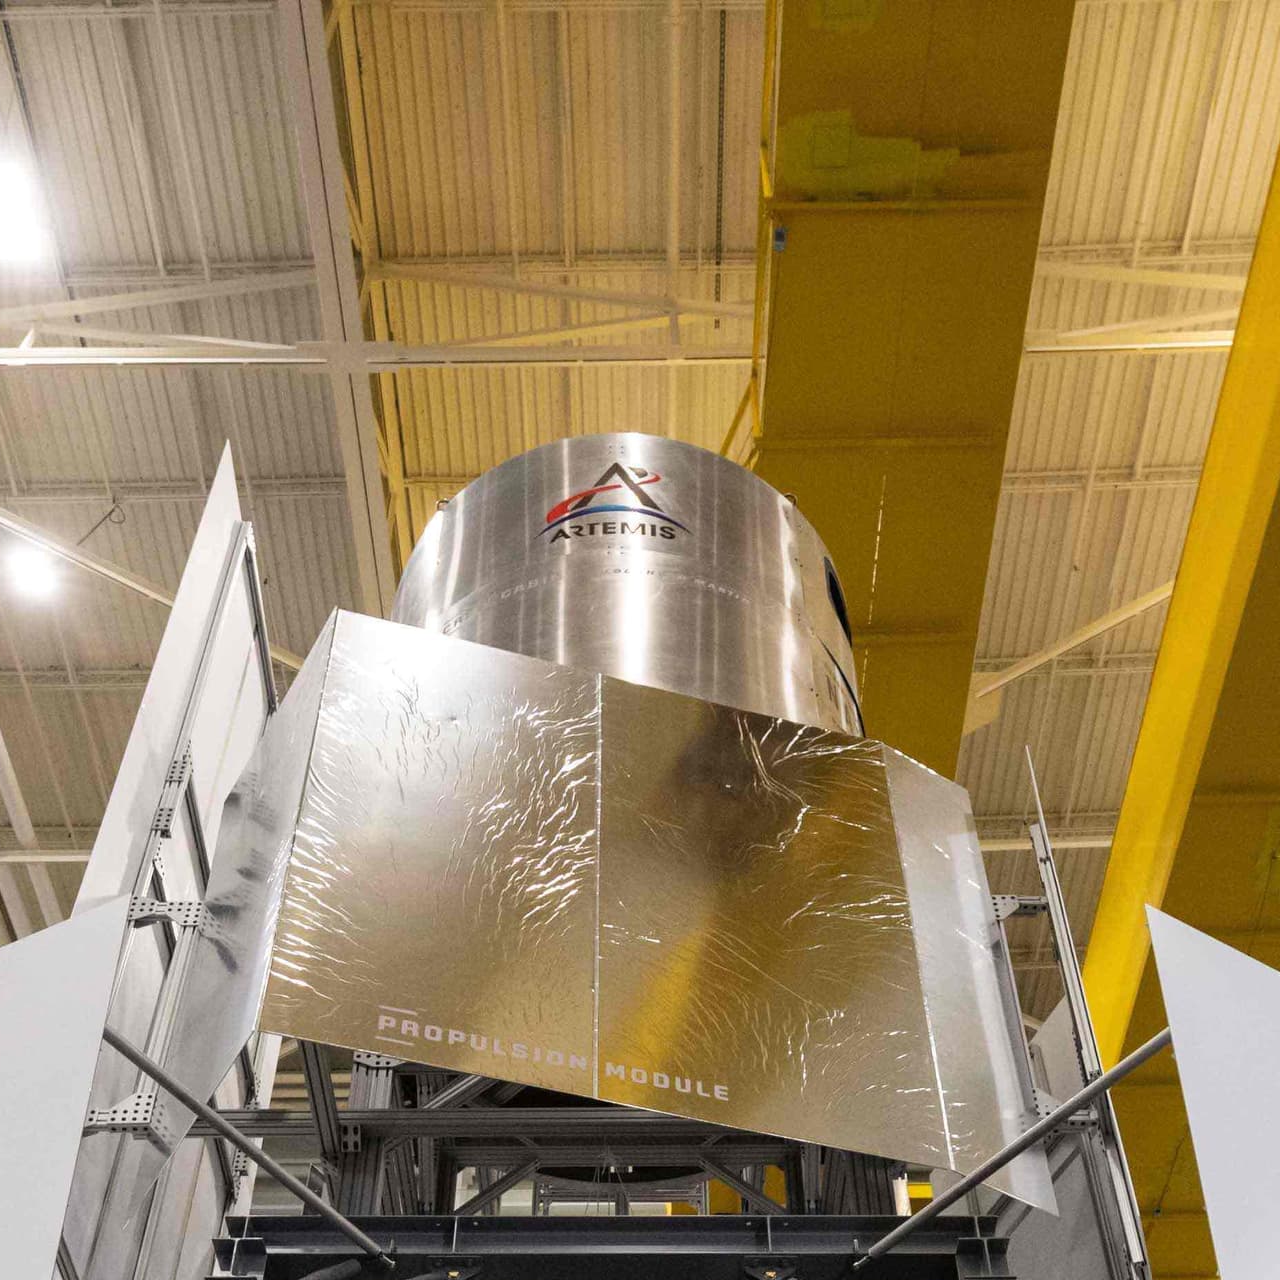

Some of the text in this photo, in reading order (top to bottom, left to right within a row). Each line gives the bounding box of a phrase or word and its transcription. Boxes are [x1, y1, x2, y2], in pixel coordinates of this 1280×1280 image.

[549, 521, 676, 544] ARTEMIS
[376, 1014, 729, 1101] PROPULSION MODULE
